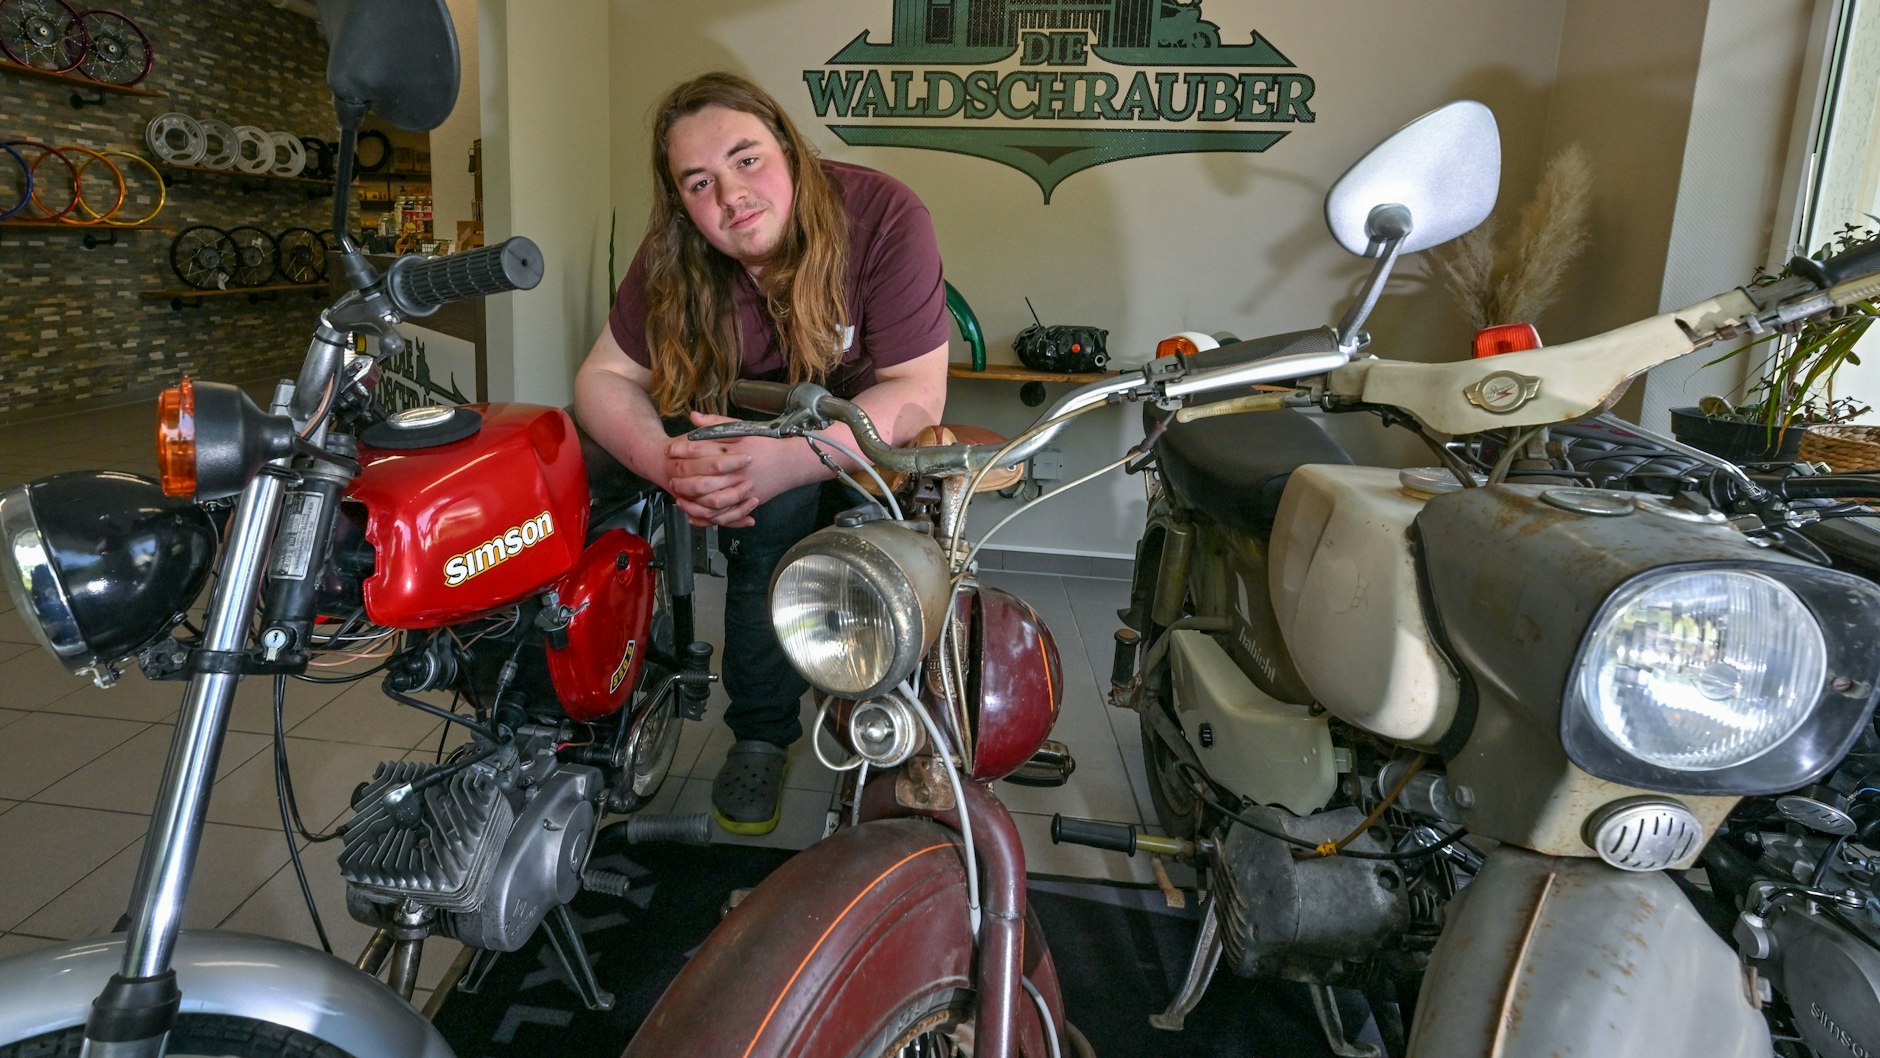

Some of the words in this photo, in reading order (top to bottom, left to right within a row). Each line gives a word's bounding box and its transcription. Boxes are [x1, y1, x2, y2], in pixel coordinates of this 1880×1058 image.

[1020, 31, 1089, 66] DIE
[803, 70, 1316, 123] WALDSCHRAUBER
[1238, 626, 1276, 684] habicht
